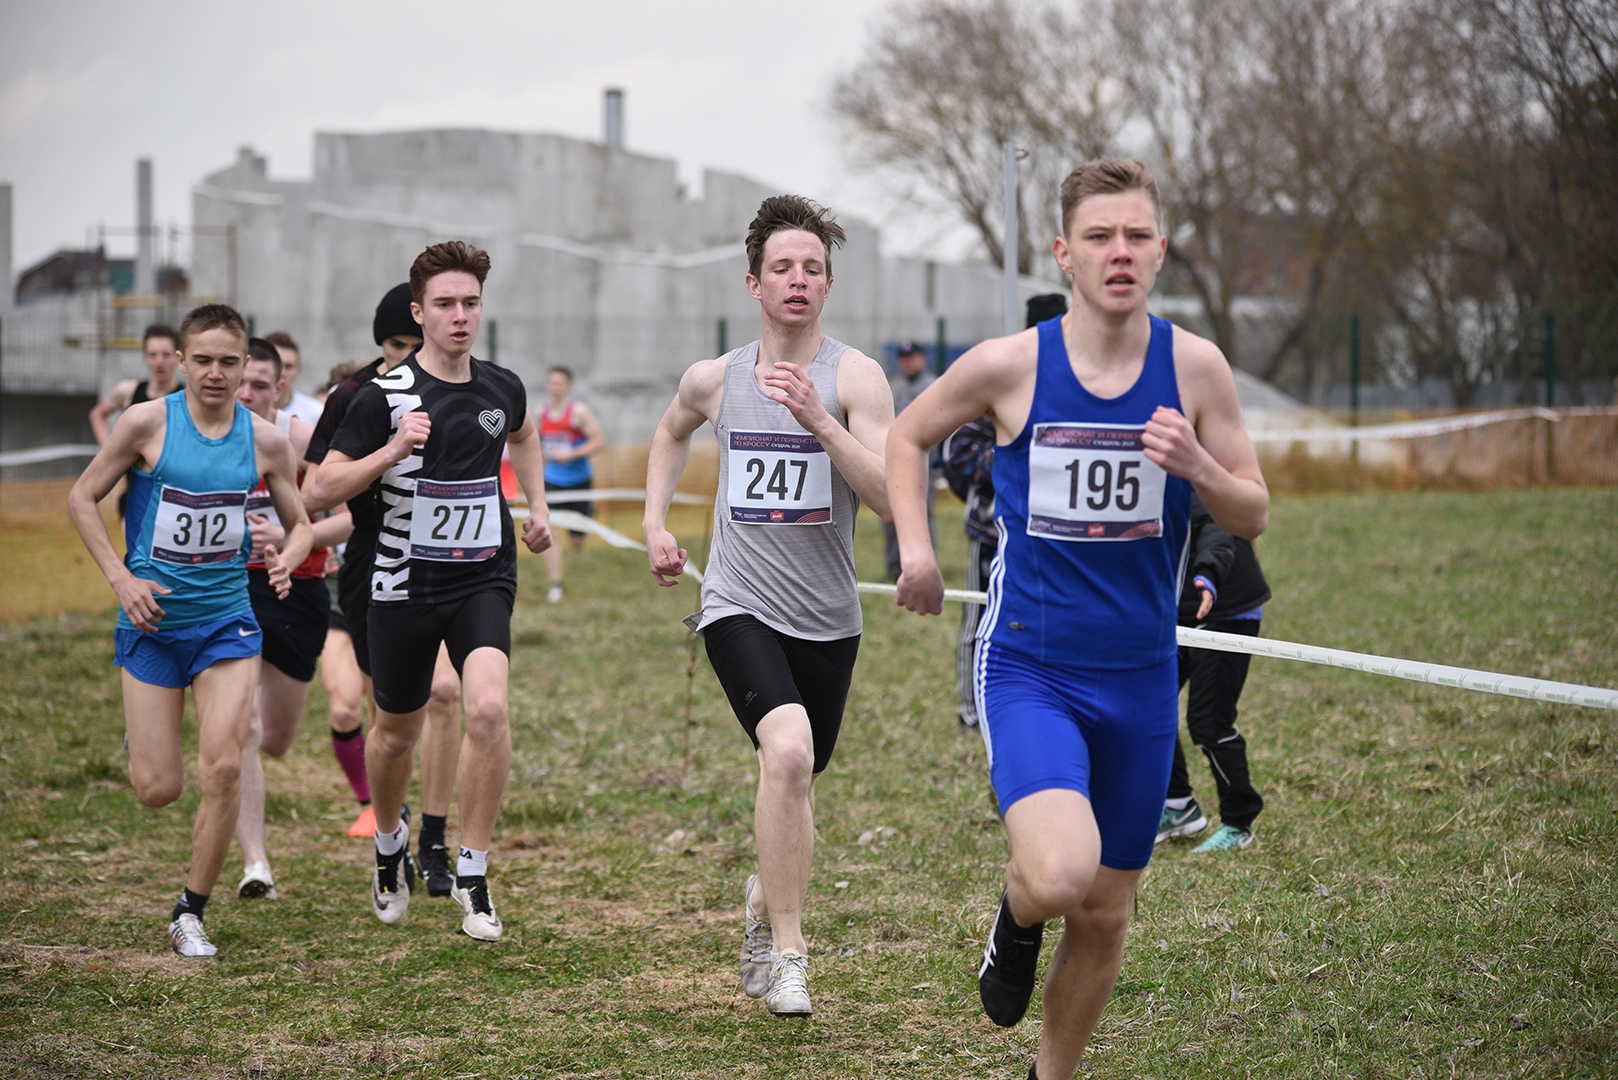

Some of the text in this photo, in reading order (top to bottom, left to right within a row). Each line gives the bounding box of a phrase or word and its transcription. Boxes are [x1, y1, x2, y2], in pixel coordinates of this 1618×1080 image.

[371, 364, 425, 601] RUNNNG
[746, 457, 809, 501] 247
[1064, 459, 1141, 512] 195
[173, 513, 227, 547] 312
[431, 504, 486, 541] 277
